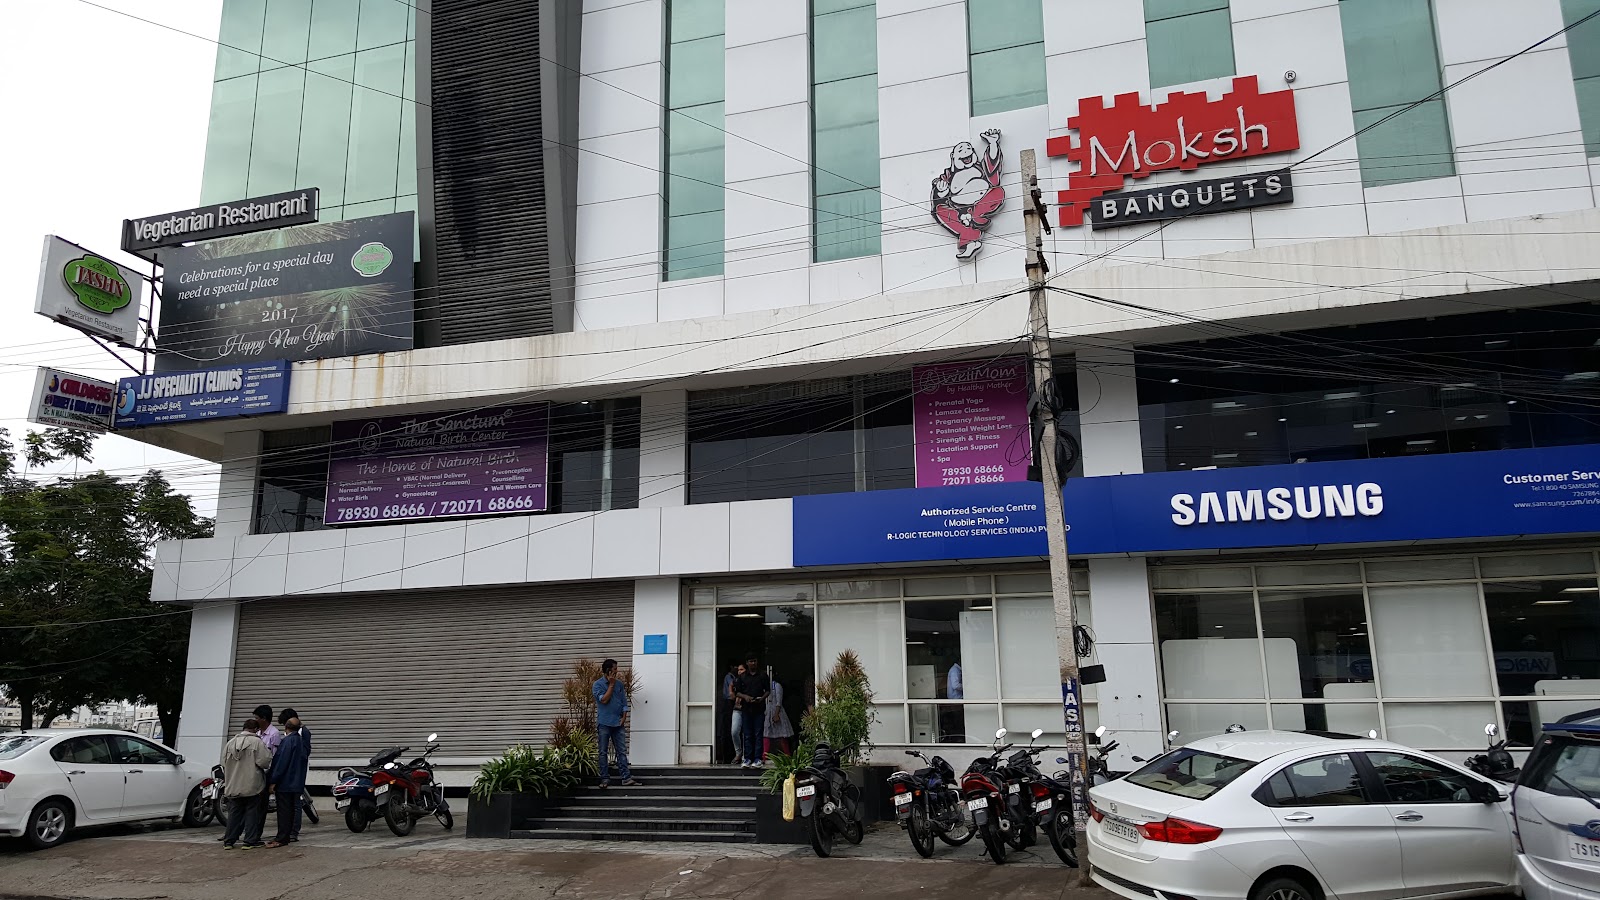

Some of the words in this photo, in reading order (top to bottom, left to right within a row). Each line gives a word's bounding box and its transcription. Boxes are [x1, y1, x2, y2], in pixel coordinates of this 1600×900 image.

[1088, 105, 1269, 176] Moksh
[1101, 174, 1283, 219] BANQUETS
[133, 211, 215, 243] Vegetarian
[218, 192, 309, 227] Restaurant
[180, 265, 243, 284] Celebrations
[243, 263, 261, 281] for
[263, 261, 270, 271] a
[272, 252, 309, 273] special
[312, 251, 334, 268] day
[72, 264, 126, 298] JASHN
[178, 286, 201, 300] need
[203, 287, 210, 296] a
[212, 279, 249, 298] special
[249, 276, 279, 293] place
[64, 306, 94, 322] Vegetarian
[94, 317, 123, 334] Restaurant
[261, 307, 298, 324] 2017
[218, 334, 266, 356] Happy
[268, 328, 300, 347] New
[302, 324, 337, 353] Year
[153, 372, 206, 399] SPECIALITY
[206, 368, 244, 392] CLINICS
[957, 383, 984, 393] Healthy
[986, 381, 1013, 389] Mother
[935, 399, 964, 407] Prenatal
[964, 406, 990, 414] Classes
[401, 418, 429, 434] The
[435, 415, 505, 433] Sanctum
[935, 417, 972, 426] Pregnancy
[973, 414, 1005, 423] Massage
[935, 426, 968, 435] Postnatal
[970, 424, 996, 432] Weight
[395, 433, 436, 448] Natural
[440, 432, 467, 444] Birth
[471, 430, 508, 442] Center
[936, 436, 966, 445] Strength
[970, 443, 999, 451] Support
[357, 462, 378, 475] The
[382, 461, 416, 473] Home
[421, 456, 434, 470] of
[437, 453, 484, 469] Natural
[419, 473, 443, 481] (Normal
[444, 472, 467, 480] Delivery
[492, 467, 532, 476] Preconception
[942, 467, 971, 477] 78930
[973, 465, 1004, 474] 68666
[442, 479, 471, 487] Cesarean)
[491, 475, 525, 483] Counselling
[942, 476, 971, 486] 72071
[974, 474, 1005, 484] 68666
[1503, 473, 1569, 485] Customer
[360, 485, 382, 493] Delivery
[402, 490, 438, 498] Gynaecology
[337, 505, 379, 521] 78930
[382, 502, 426, 518] 68666
[429, 501, 437, 516] /
[440, 498, 482, 514] 72071
[488, 495, 533, 511] 68666
[920, 506, 970, 517] Authorized
[971, 505, 1005, 514] Service
[1006, 503, 1037, 512] Centre
[1170, 482, 1384, 526] SAMSUNG
[887, 532, 917, 540] R-LOGIC
[917, 529, 969, 539] TECHNOLOGY
[970, 527, 1008, 537] SERVICES
[1009, 525, 1038, 534] (INDIA)
[1066, 724, 1081, 732] IPS
